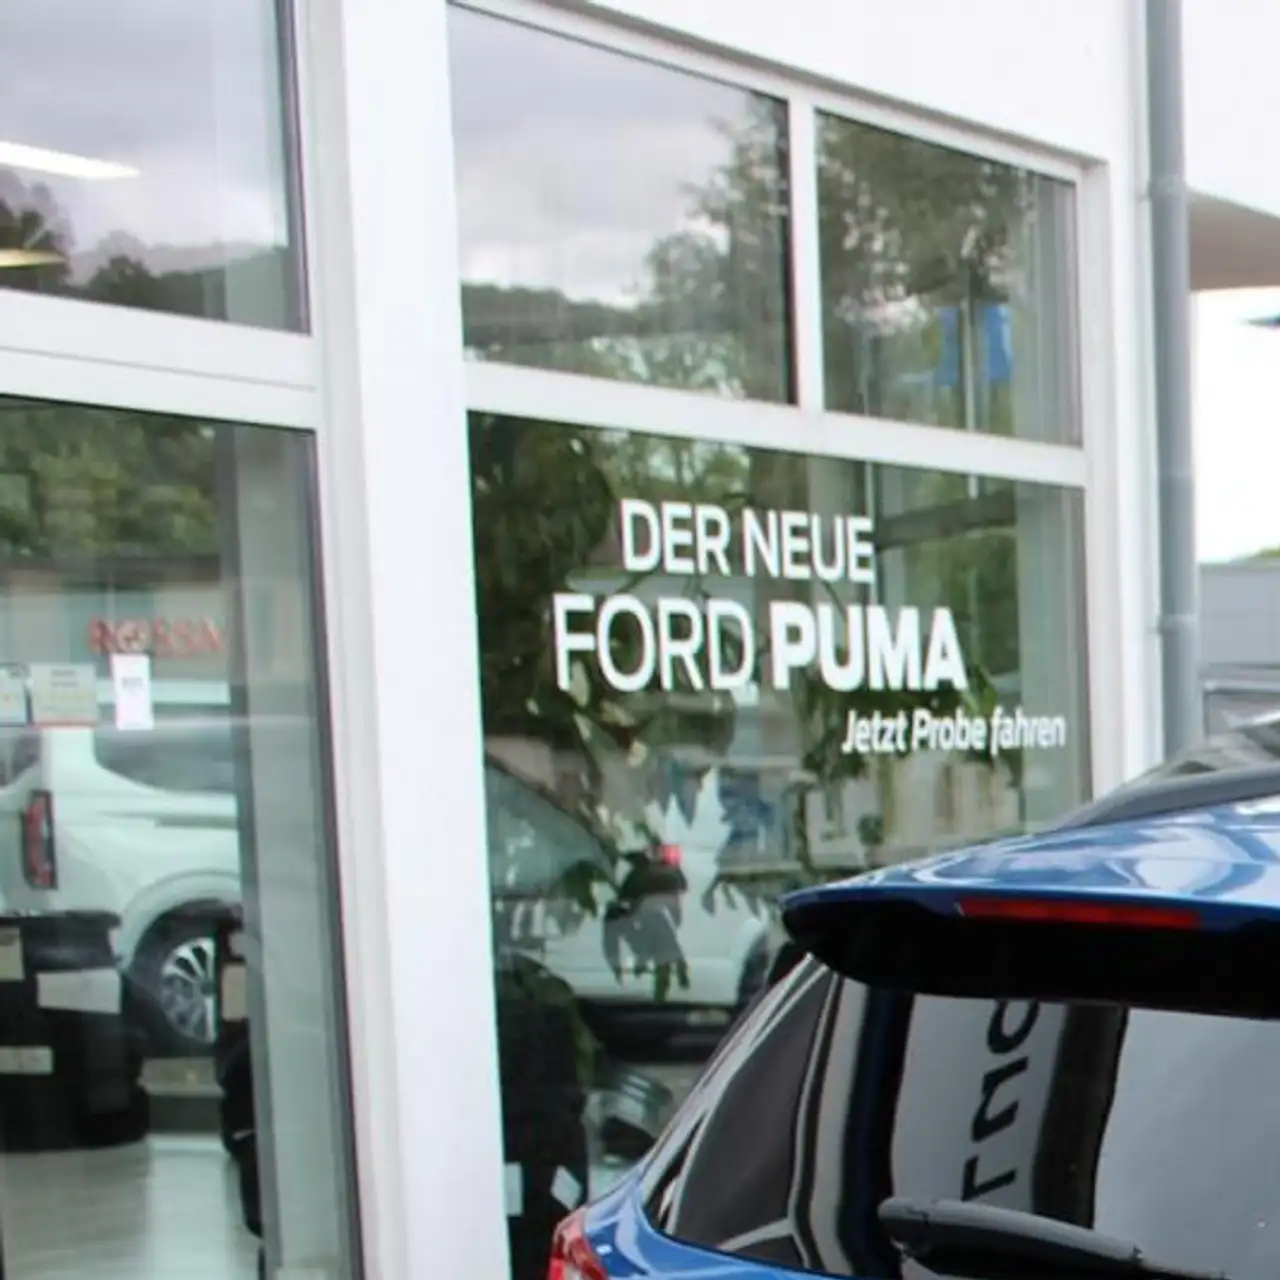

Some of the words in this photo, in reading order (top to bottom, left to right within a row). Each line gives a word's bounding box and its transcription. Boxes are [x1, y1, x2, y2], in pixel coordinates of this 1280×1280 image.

[621, 498, 732, 577] DER
[742, 508, 875, 584] NEUE
[553, 592, 756, 692] FORD
[769, 601, 969, 693] PUMA
[841, 707, 908, 754] Jetzt
[912, 707, 987, 752] Probe
[990, 705, 1067, 757] fahren
